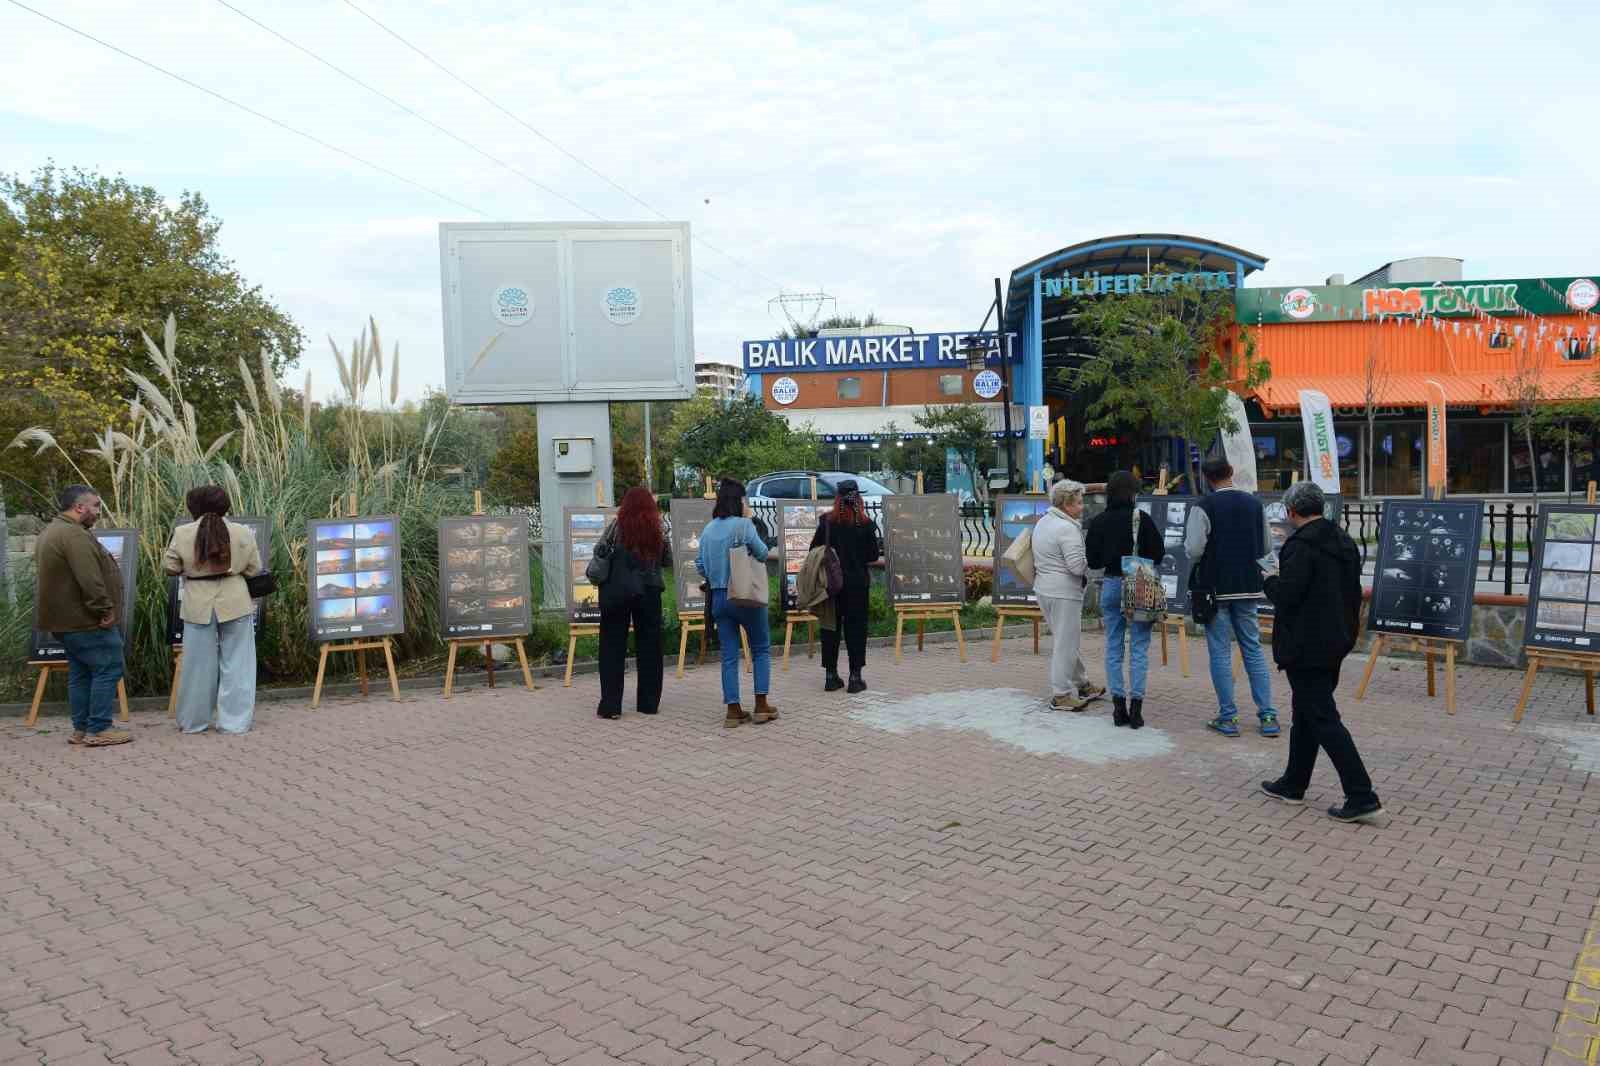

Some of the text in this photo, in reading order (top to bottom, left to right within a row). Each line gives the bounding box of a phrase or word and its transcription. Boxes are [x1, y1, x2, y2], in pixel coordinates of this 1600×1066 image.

[749, 332, 1017, 367] BALIK MARKET REAT
